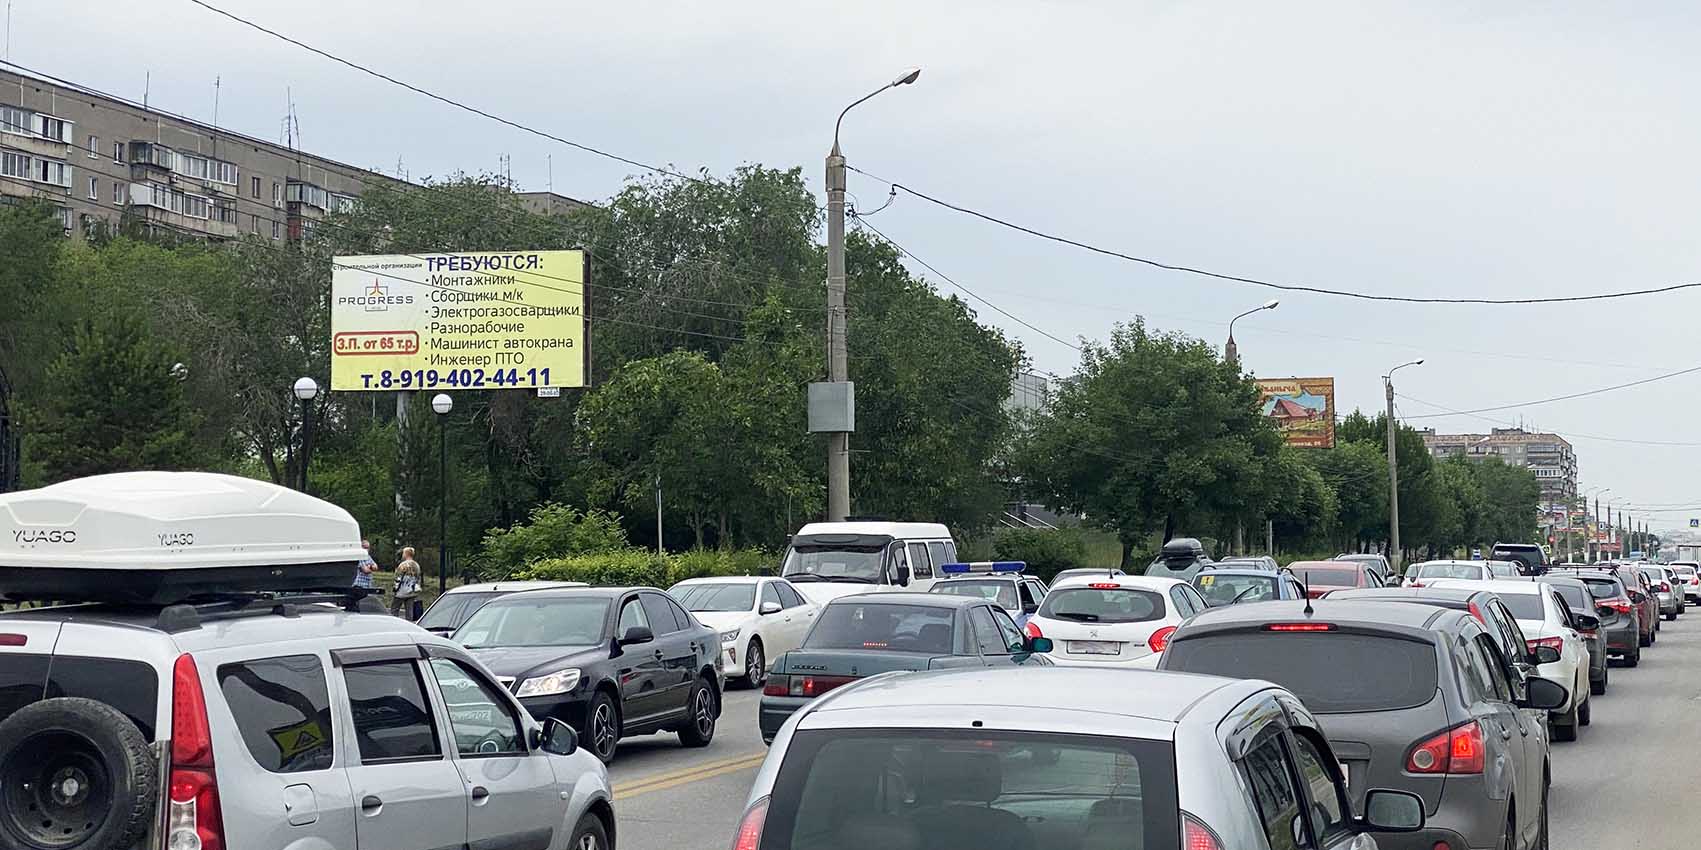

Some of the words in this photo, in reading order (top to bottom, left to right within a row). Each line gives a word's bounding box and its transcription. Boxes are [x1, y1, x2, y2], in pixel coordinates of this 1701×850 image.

[426, 255, 544, 272] ТРЕБУЮТСЯ:
[431, 275, 515, 286] Монтажники
[339, 295, 414, 305] PROGRESS
[431, 290, 498, 304] Сборщики
[502, 289, 524, 301] м/к
[431, 305, 580, 320] Электрогазосварщики
[430, 322, 525, 336] Разнорабочие
[363, 340, 377, 349] от
[380, 337, 394, 349] 65
[397, 339, 416, 352] т.р.
[430, 338, 499, 350] Машинист
[503, 337, 574, 351] автокрана
[430, 354, 491, 367] Инженер
[495, 352, 525, 365] ПТО
[360, 367, 551, 388] т.8-919-402-44-11
[13, 530, 76, 543] YUAGO
[158, 533, 194, 546] YUAGO
